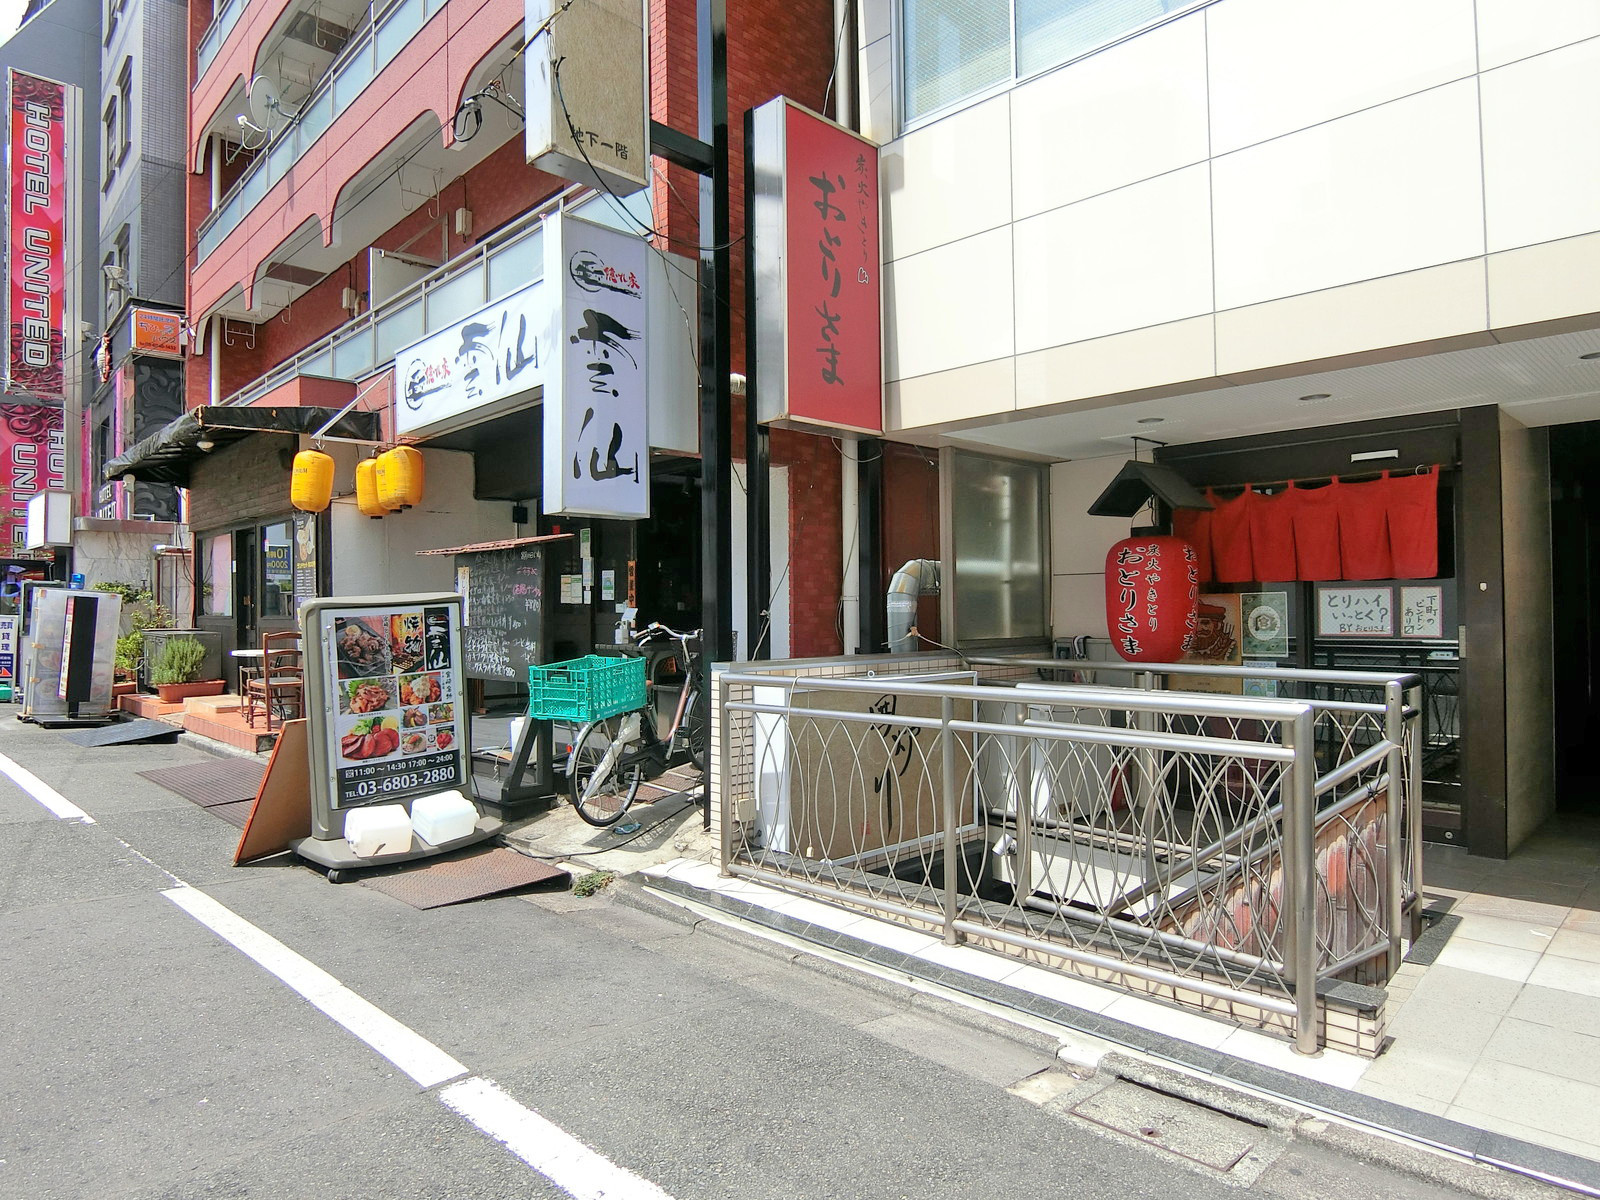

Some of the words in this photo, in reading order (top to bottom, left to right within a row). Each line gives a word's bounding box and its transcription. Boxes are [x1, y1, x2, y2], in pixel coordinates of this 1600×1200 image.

[24, 101, 50, 213] HOTEL
[571, 124, 628, 160] 地下一階
[23, 227, 50, 367] UNITED
[809, 171, 846, 386] おとりさま
[1117, 547, 1146, 655] おとりさま
[1145, 544, 1161, 632] 炭火やきとり
[1328, 595, 1381, 608] とりハイ
[1340, 624, 1353, 632] BY
[1426, 595, 1438, 625] 下町の
[404, 614, 421, 655] 焼物
[355, 767, 375, 776] 11:00
[387, 762, 406, 771] 14:30
[408, 759, 426, 768] 17:00
[436, 753, 453, 763] 24:00
[358, 766, 455, 796] 03-6803-2880
